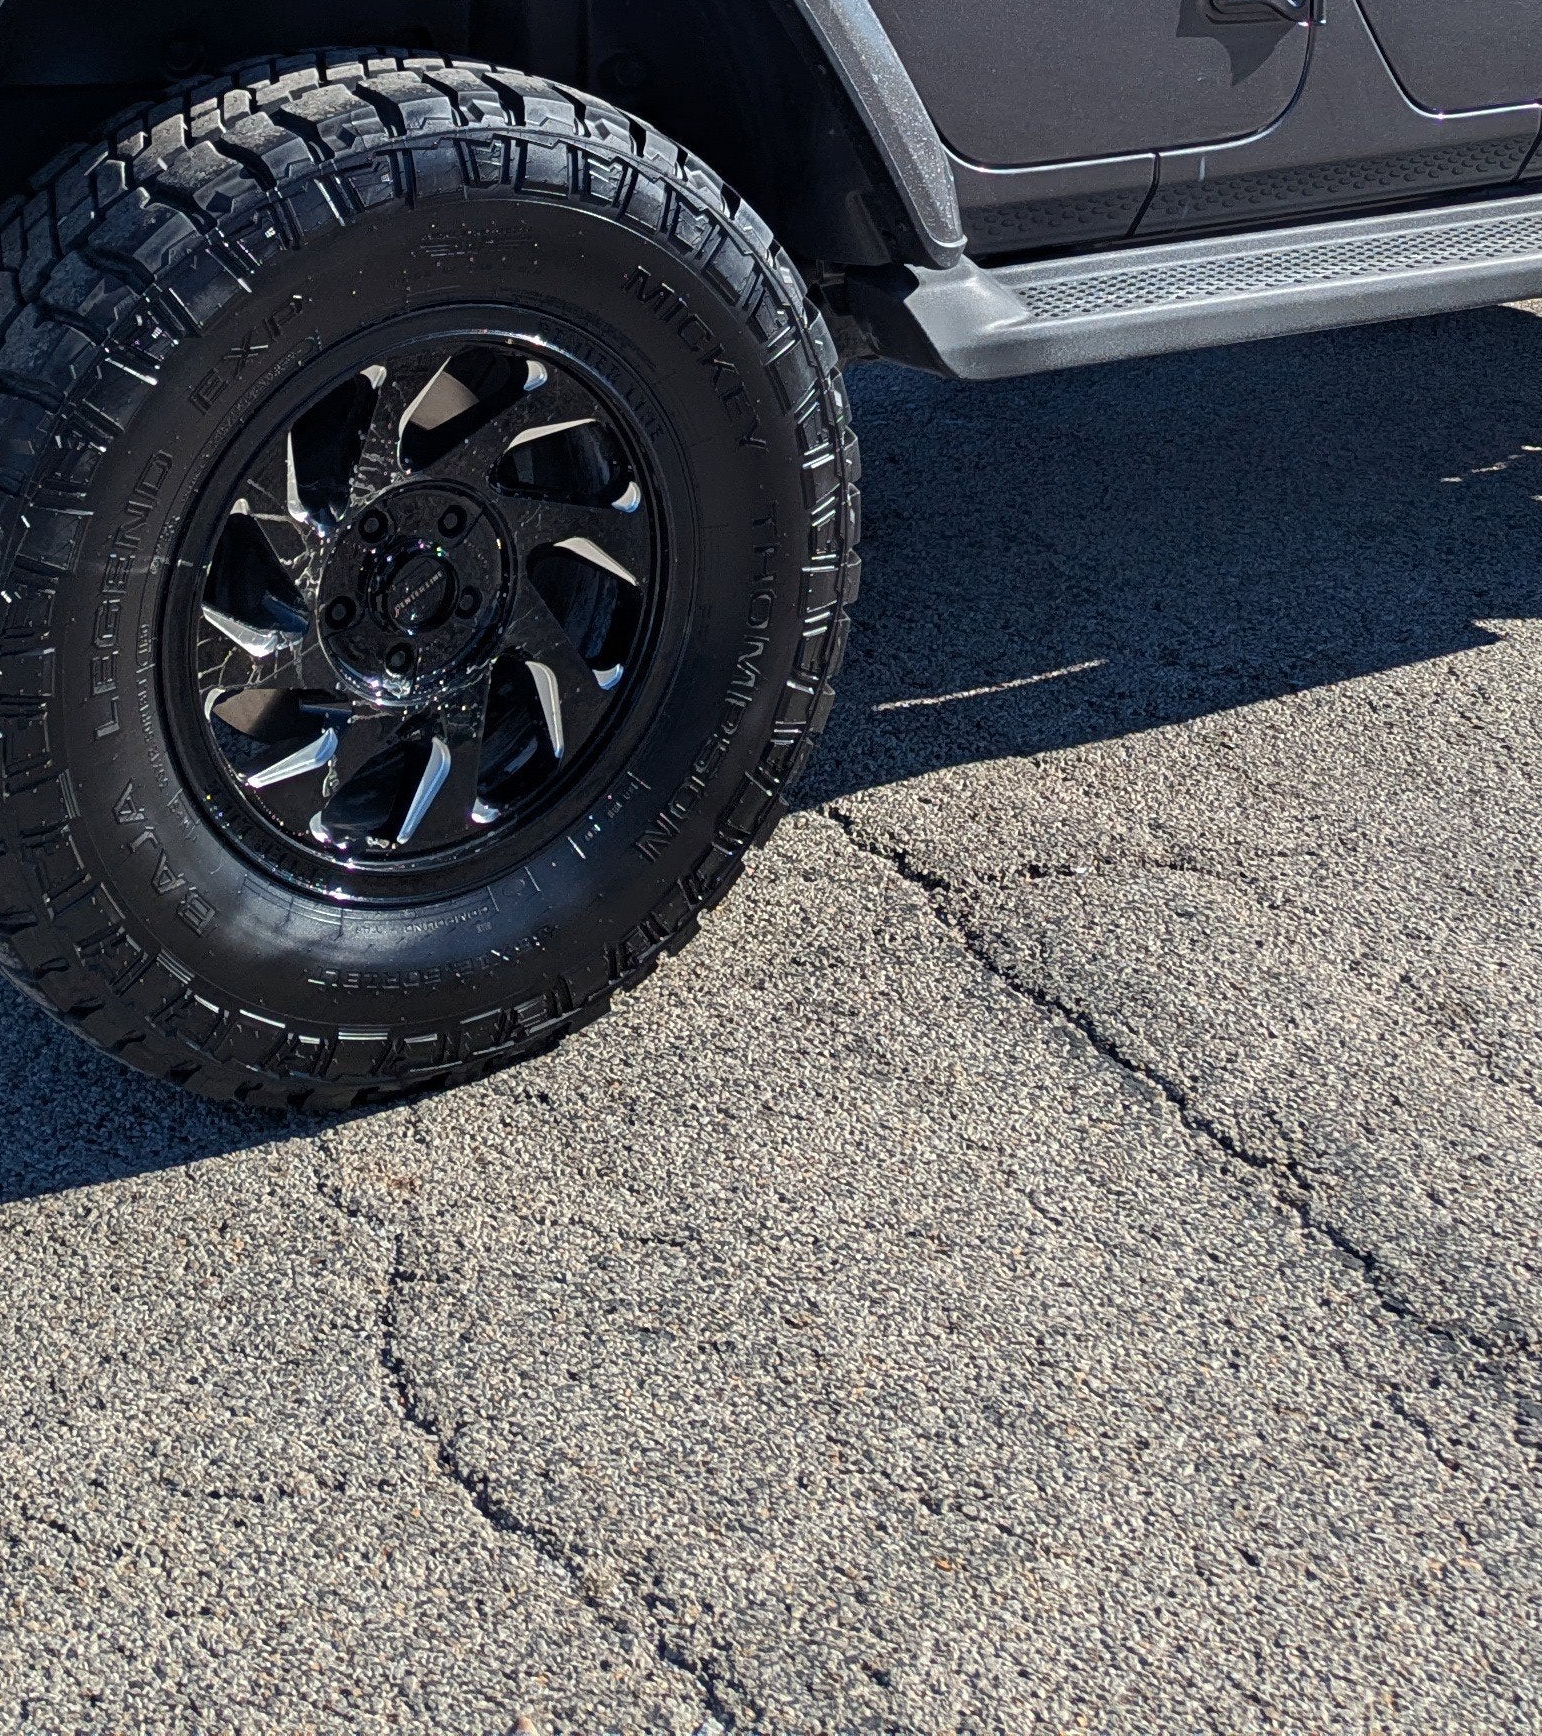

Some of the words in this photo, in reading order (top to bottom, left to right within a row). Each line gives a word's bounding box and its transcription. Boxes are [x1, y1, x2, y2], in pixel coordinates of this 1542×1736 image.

[189, 294, 303, 416] EXP
[621, 265, 770, 453] MICKEY
[92, 450, 173, 739] LEGEND
[635, 500, 780, 863] THOMPSON
[112, 779, 217, 937] BAJA
